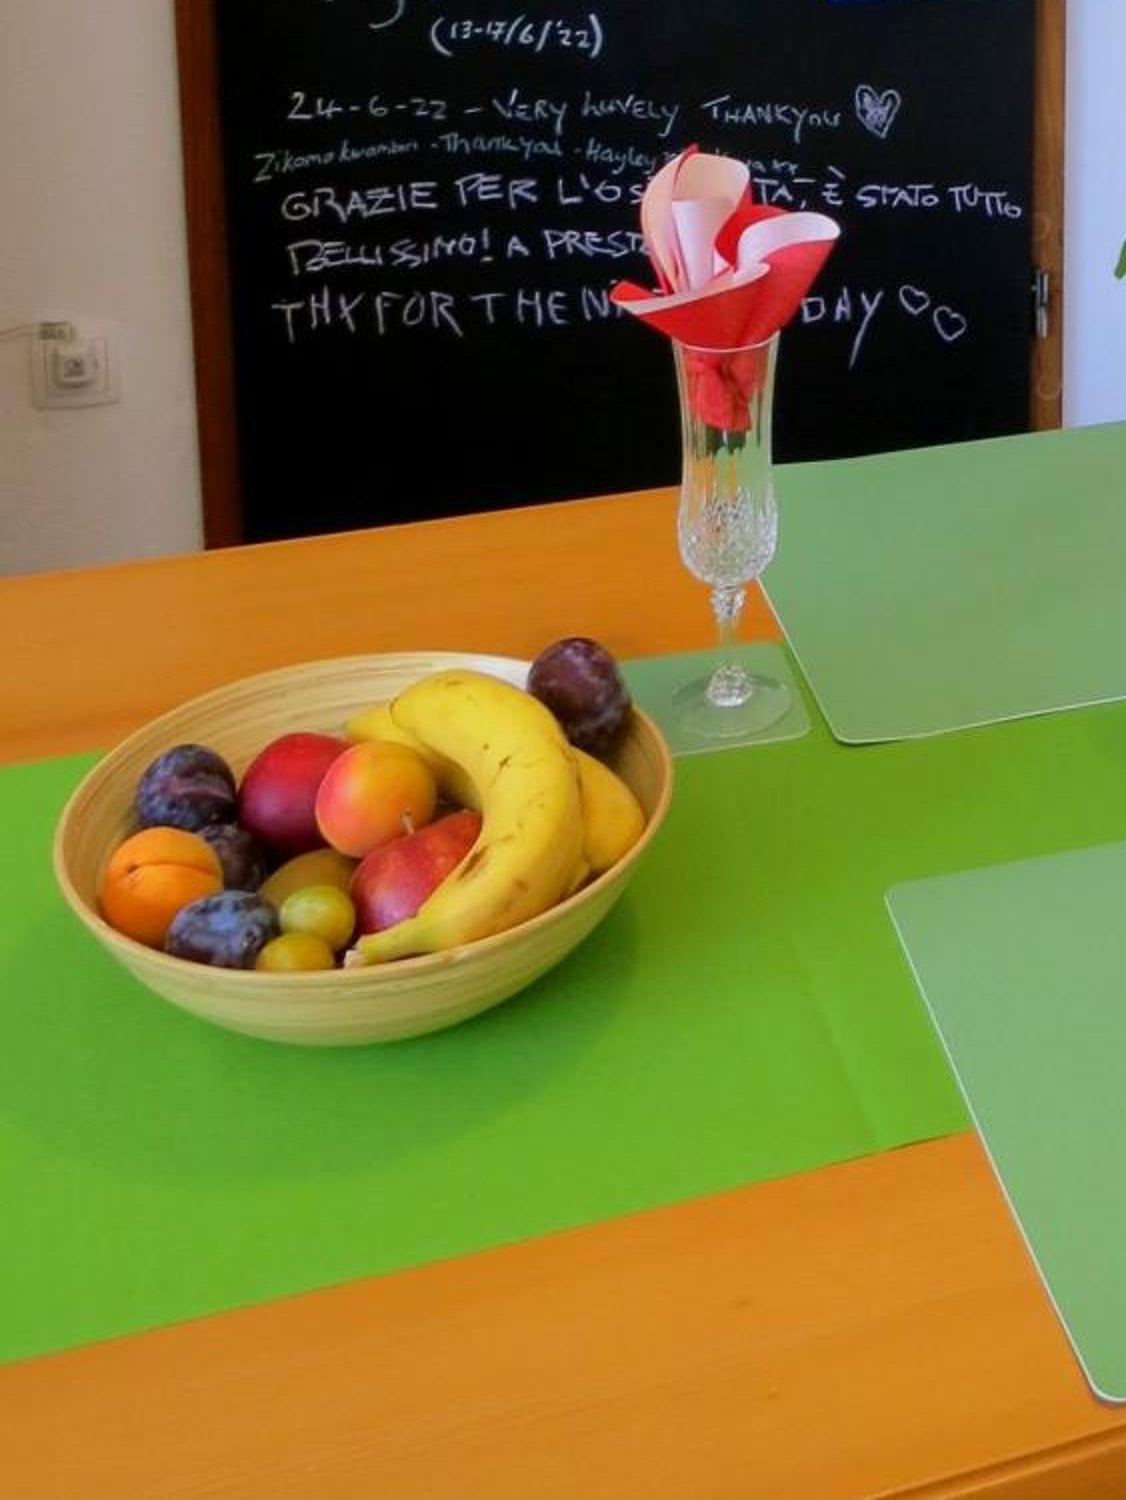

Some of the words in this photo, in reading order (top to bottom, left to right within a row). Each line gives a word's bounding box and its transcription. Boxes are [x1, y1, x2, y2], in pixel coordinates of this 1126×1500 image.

[280, 180, 439, 223] GRAZIE
[454, 172, 539, 209] PER
[855, 183, 940, 209] STATO
[948, 183, 1023, 220] TUTTO
[801, 286, 885, 370] DAY
